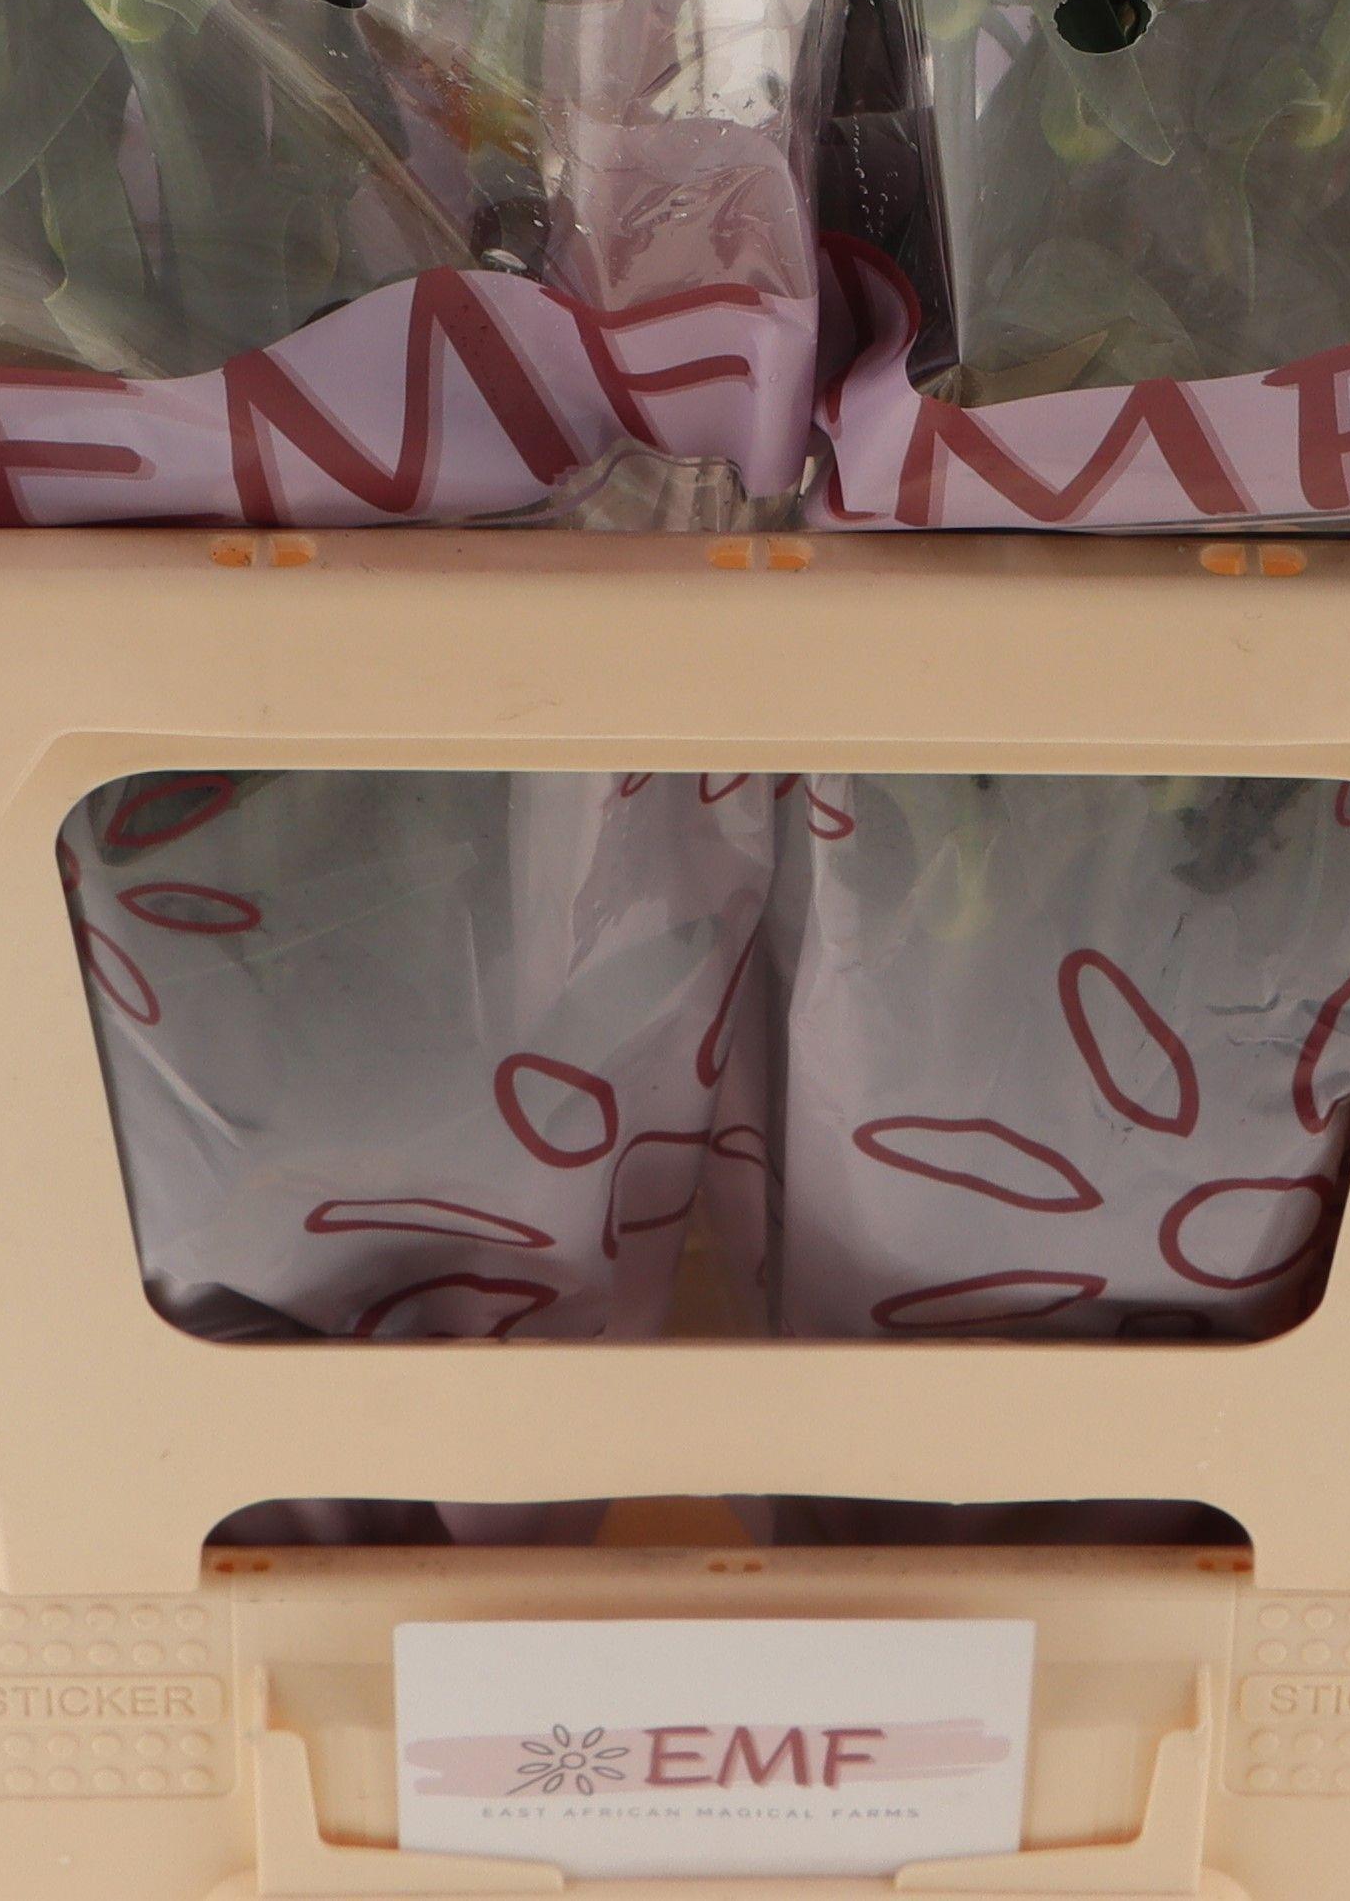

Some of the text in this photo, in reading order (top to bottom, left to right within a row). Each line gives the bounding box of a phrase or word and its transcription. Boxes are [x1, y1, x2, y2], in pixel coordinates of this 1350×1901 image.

[642, 1725, 886, 1790] EMF
[481, 1804, 921, 1819] EAST AFRICAN MAGICAL FARMS
